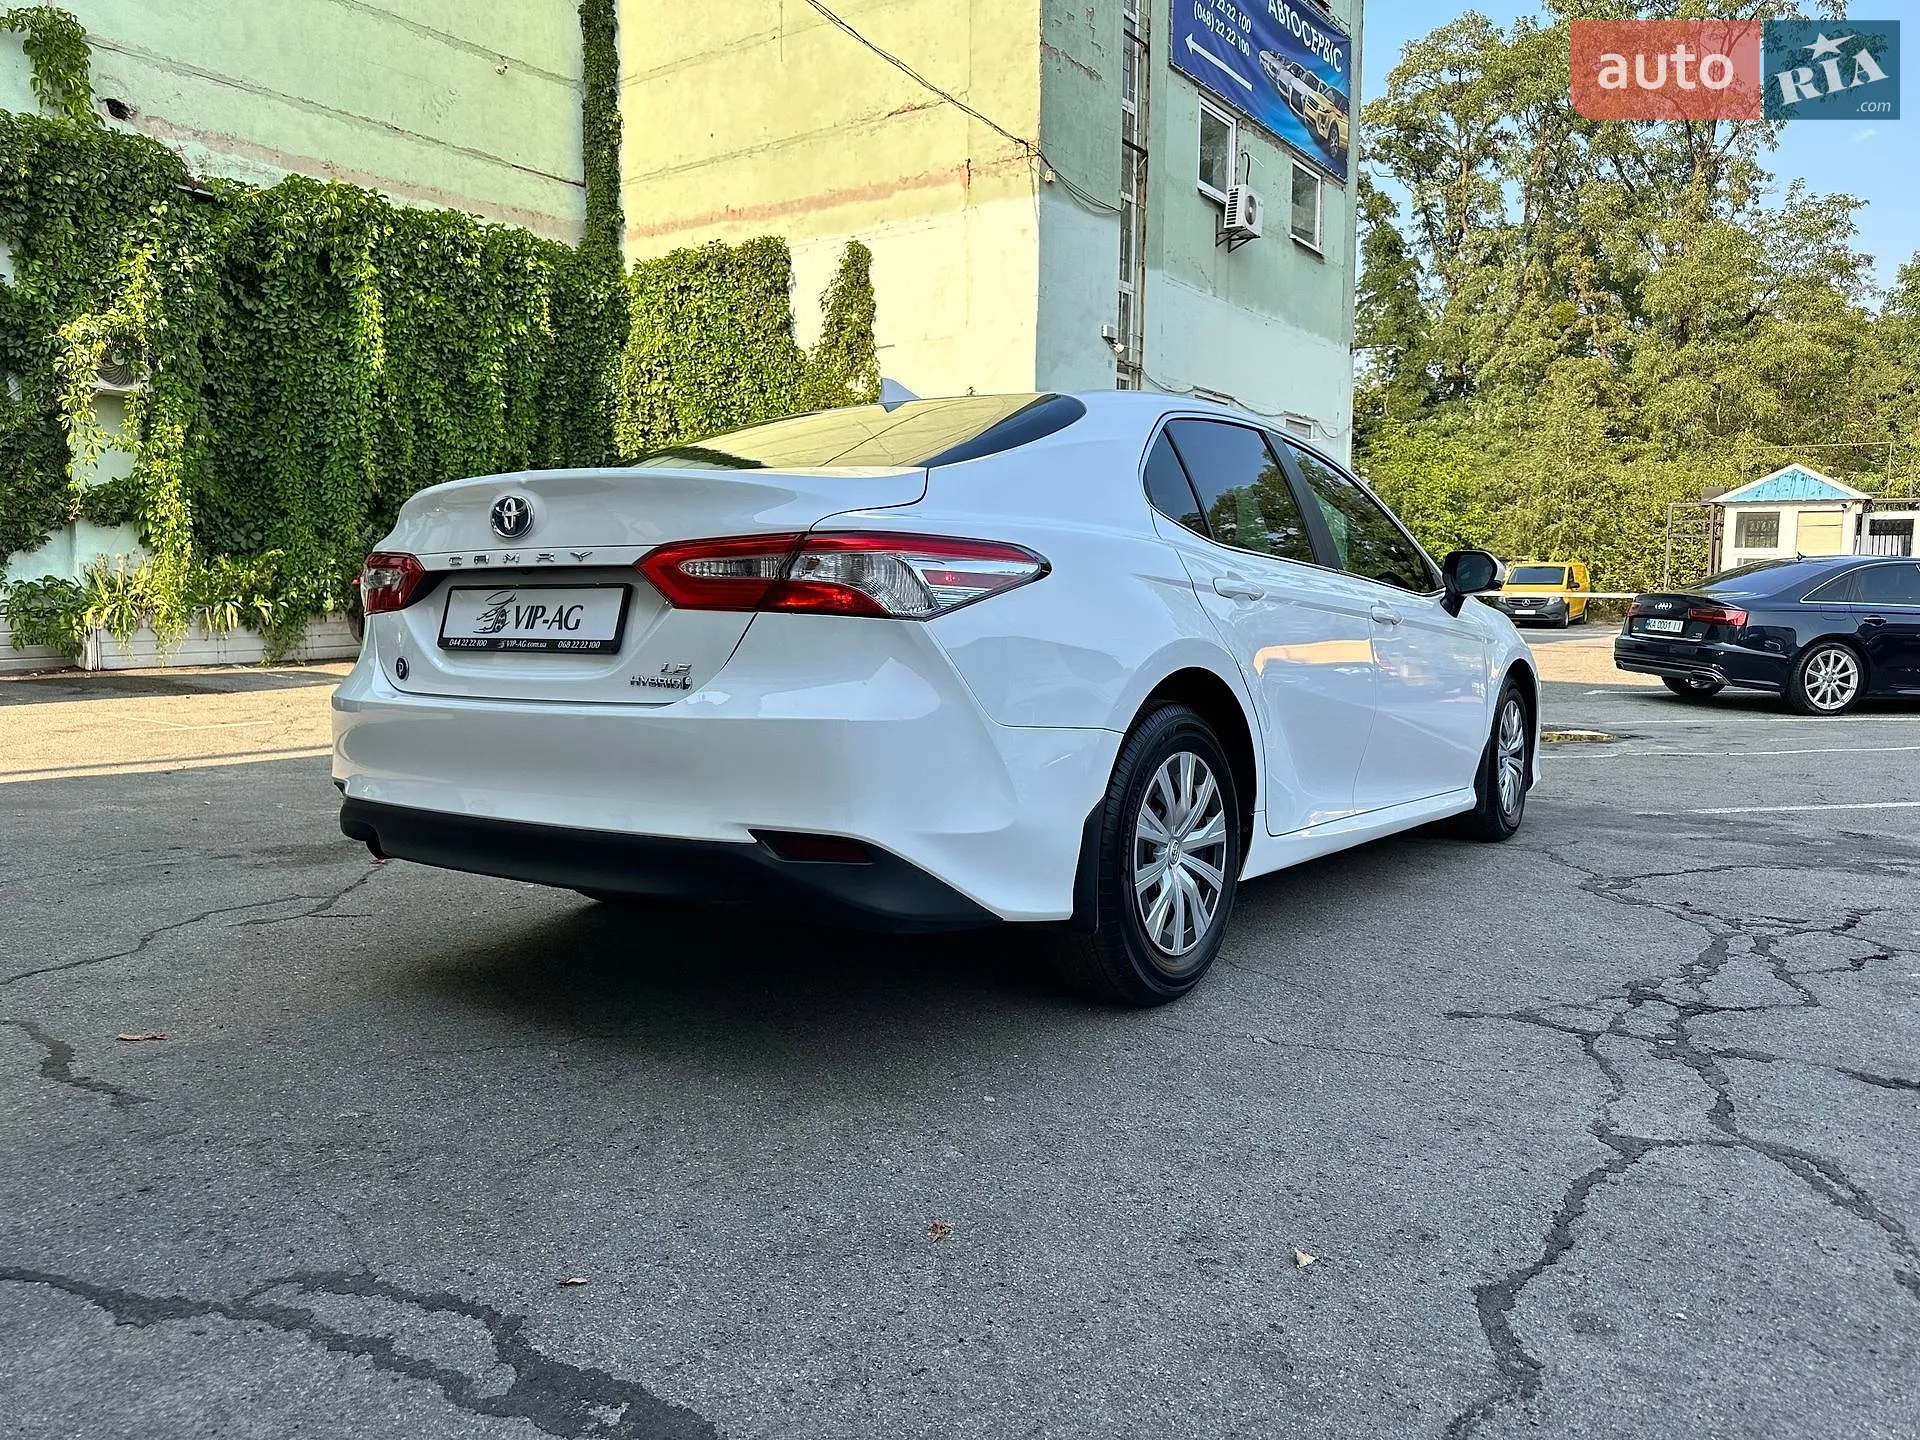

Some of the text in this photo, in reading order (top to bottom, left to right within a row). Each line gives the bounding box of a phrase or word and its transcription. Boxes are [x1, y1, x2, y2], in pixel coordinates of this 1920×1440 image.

[1194, 0, 1250, 57] (068) 22 22 100
[1227, 3, 1236, 22] 22
[1238, 11, 1251, 33] 100
[1268, 0, 1343, 73] АВТОСЕРВІС
[448, 551, 593, 567] CAMRY
[514, 604, 584, 631] VIP-AG
[506, 639, 547, 648] VIP-AG.com.ua
